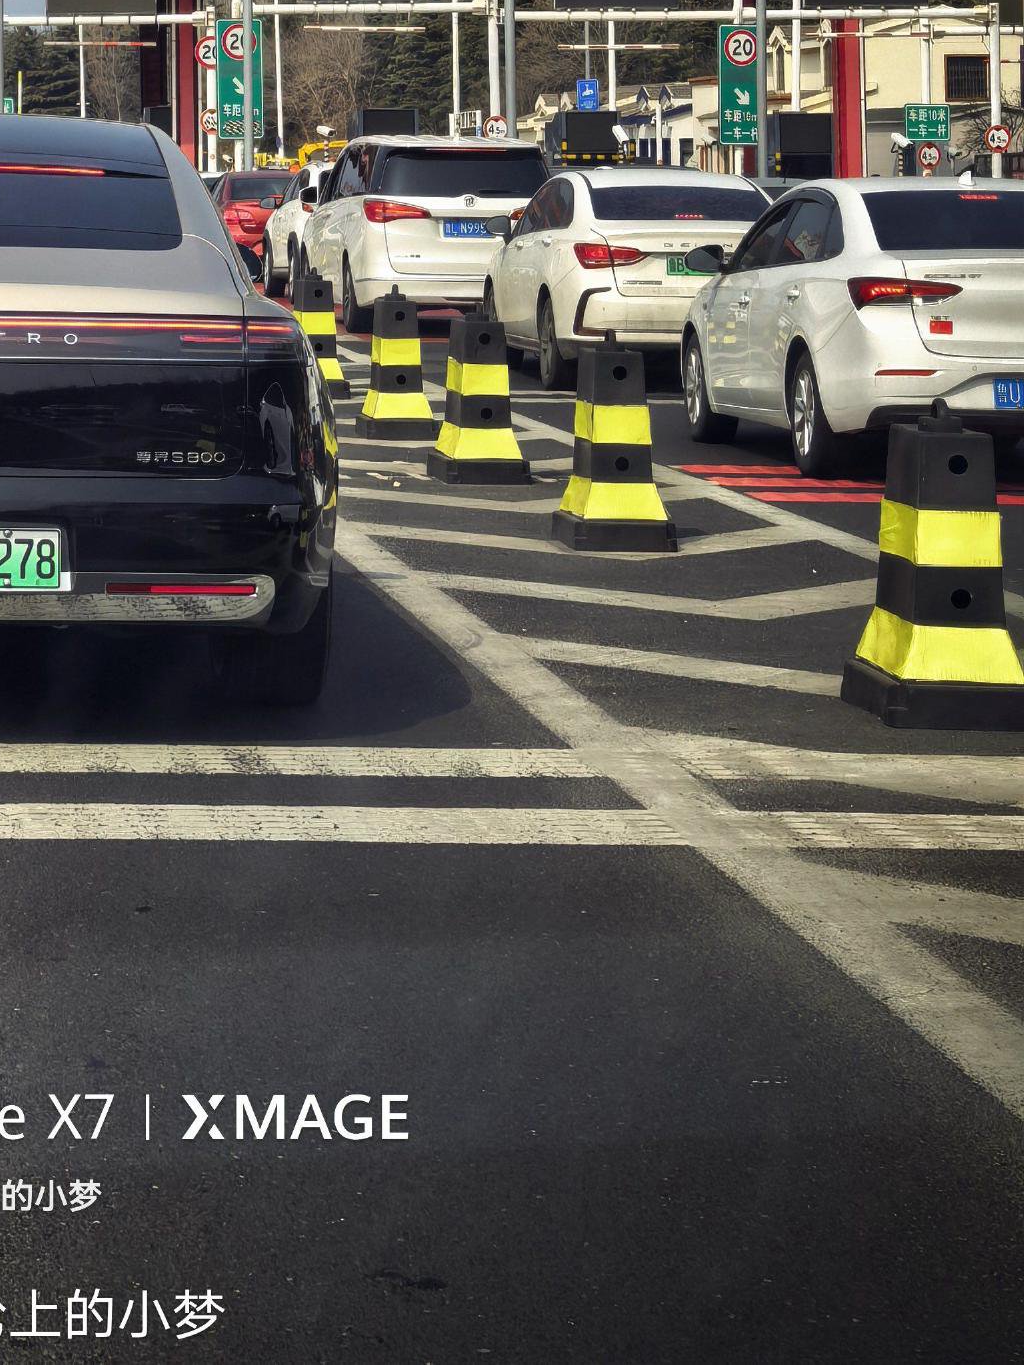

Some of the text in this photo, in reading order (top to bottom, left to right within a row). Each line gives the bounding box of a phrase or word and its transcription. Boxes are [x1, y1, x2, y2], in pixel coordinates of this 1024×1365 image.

[732, 39, 753, 56] 20
[909, 109, 946, 122] 车距10米
[909, 124, 946, 137] 一车一杆
